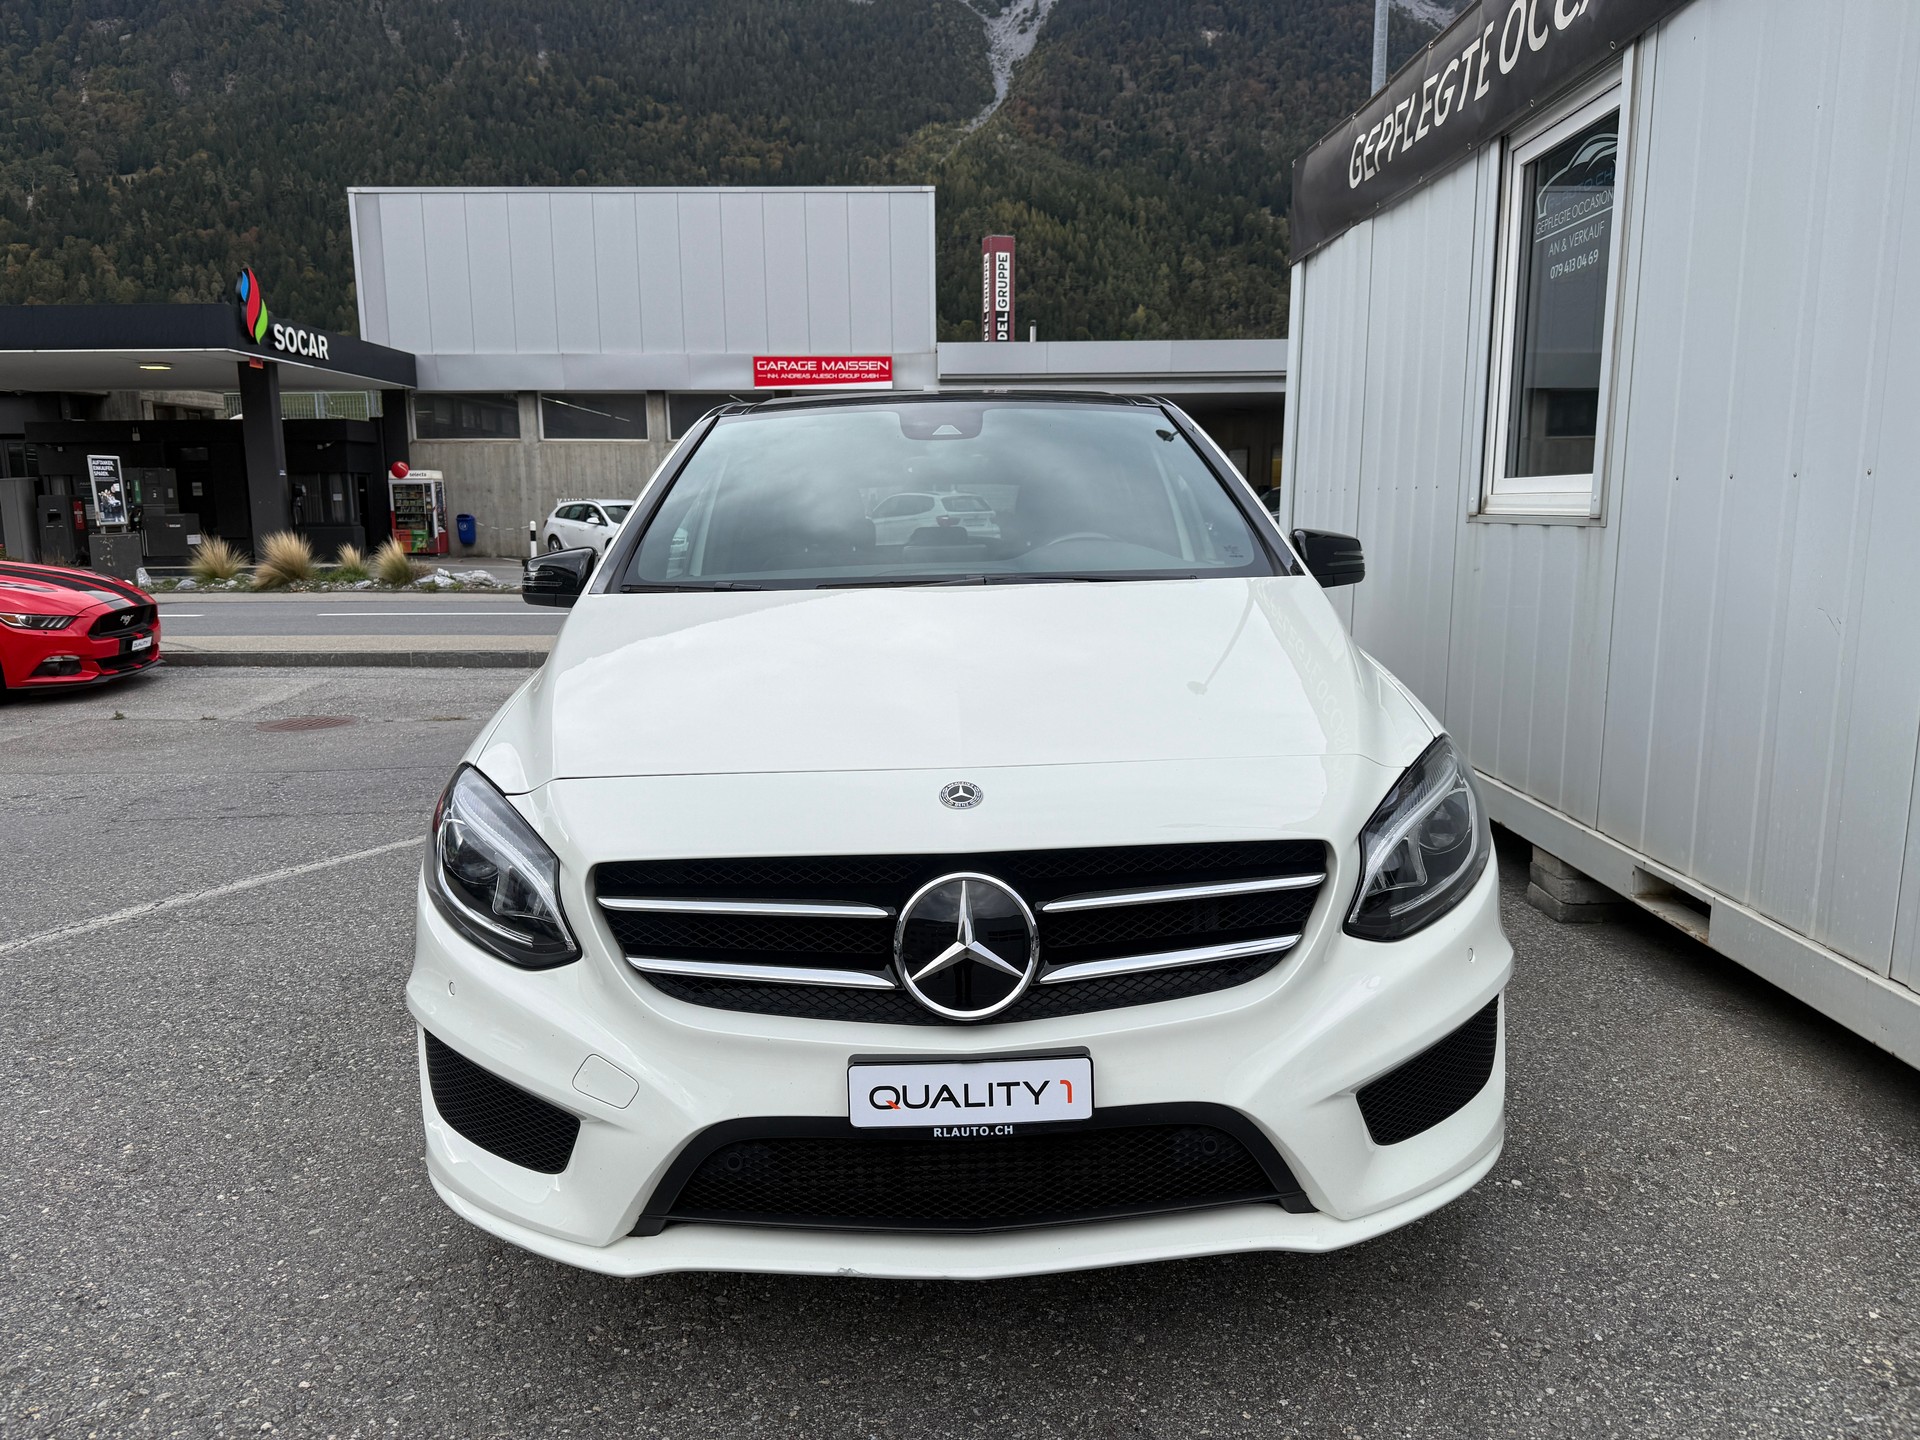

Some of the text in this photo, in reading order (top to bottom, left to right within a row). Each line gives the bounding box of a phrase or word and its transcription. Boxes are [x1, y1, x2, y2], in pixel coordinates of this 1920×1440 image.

[1349, 0, 1589, 189] GEPFLEGTE OC
[1535, 207, 1571, 235] GEPFLEGTE
[1548, 220, 1605, 257] AN & VERKAUF
[1550, 249, 1599, 279] 079 413 04 69
[998, 254, 1008, 308] GRUPPE
[273, 323, 329, 360] SOCAR
[756, 361, 888, 371] GARAGE MAISSEN
[869, 1079, 1072, 1110] QUALITY 1
[933, 1125, 1014, 1137] RLAUTO.CH
